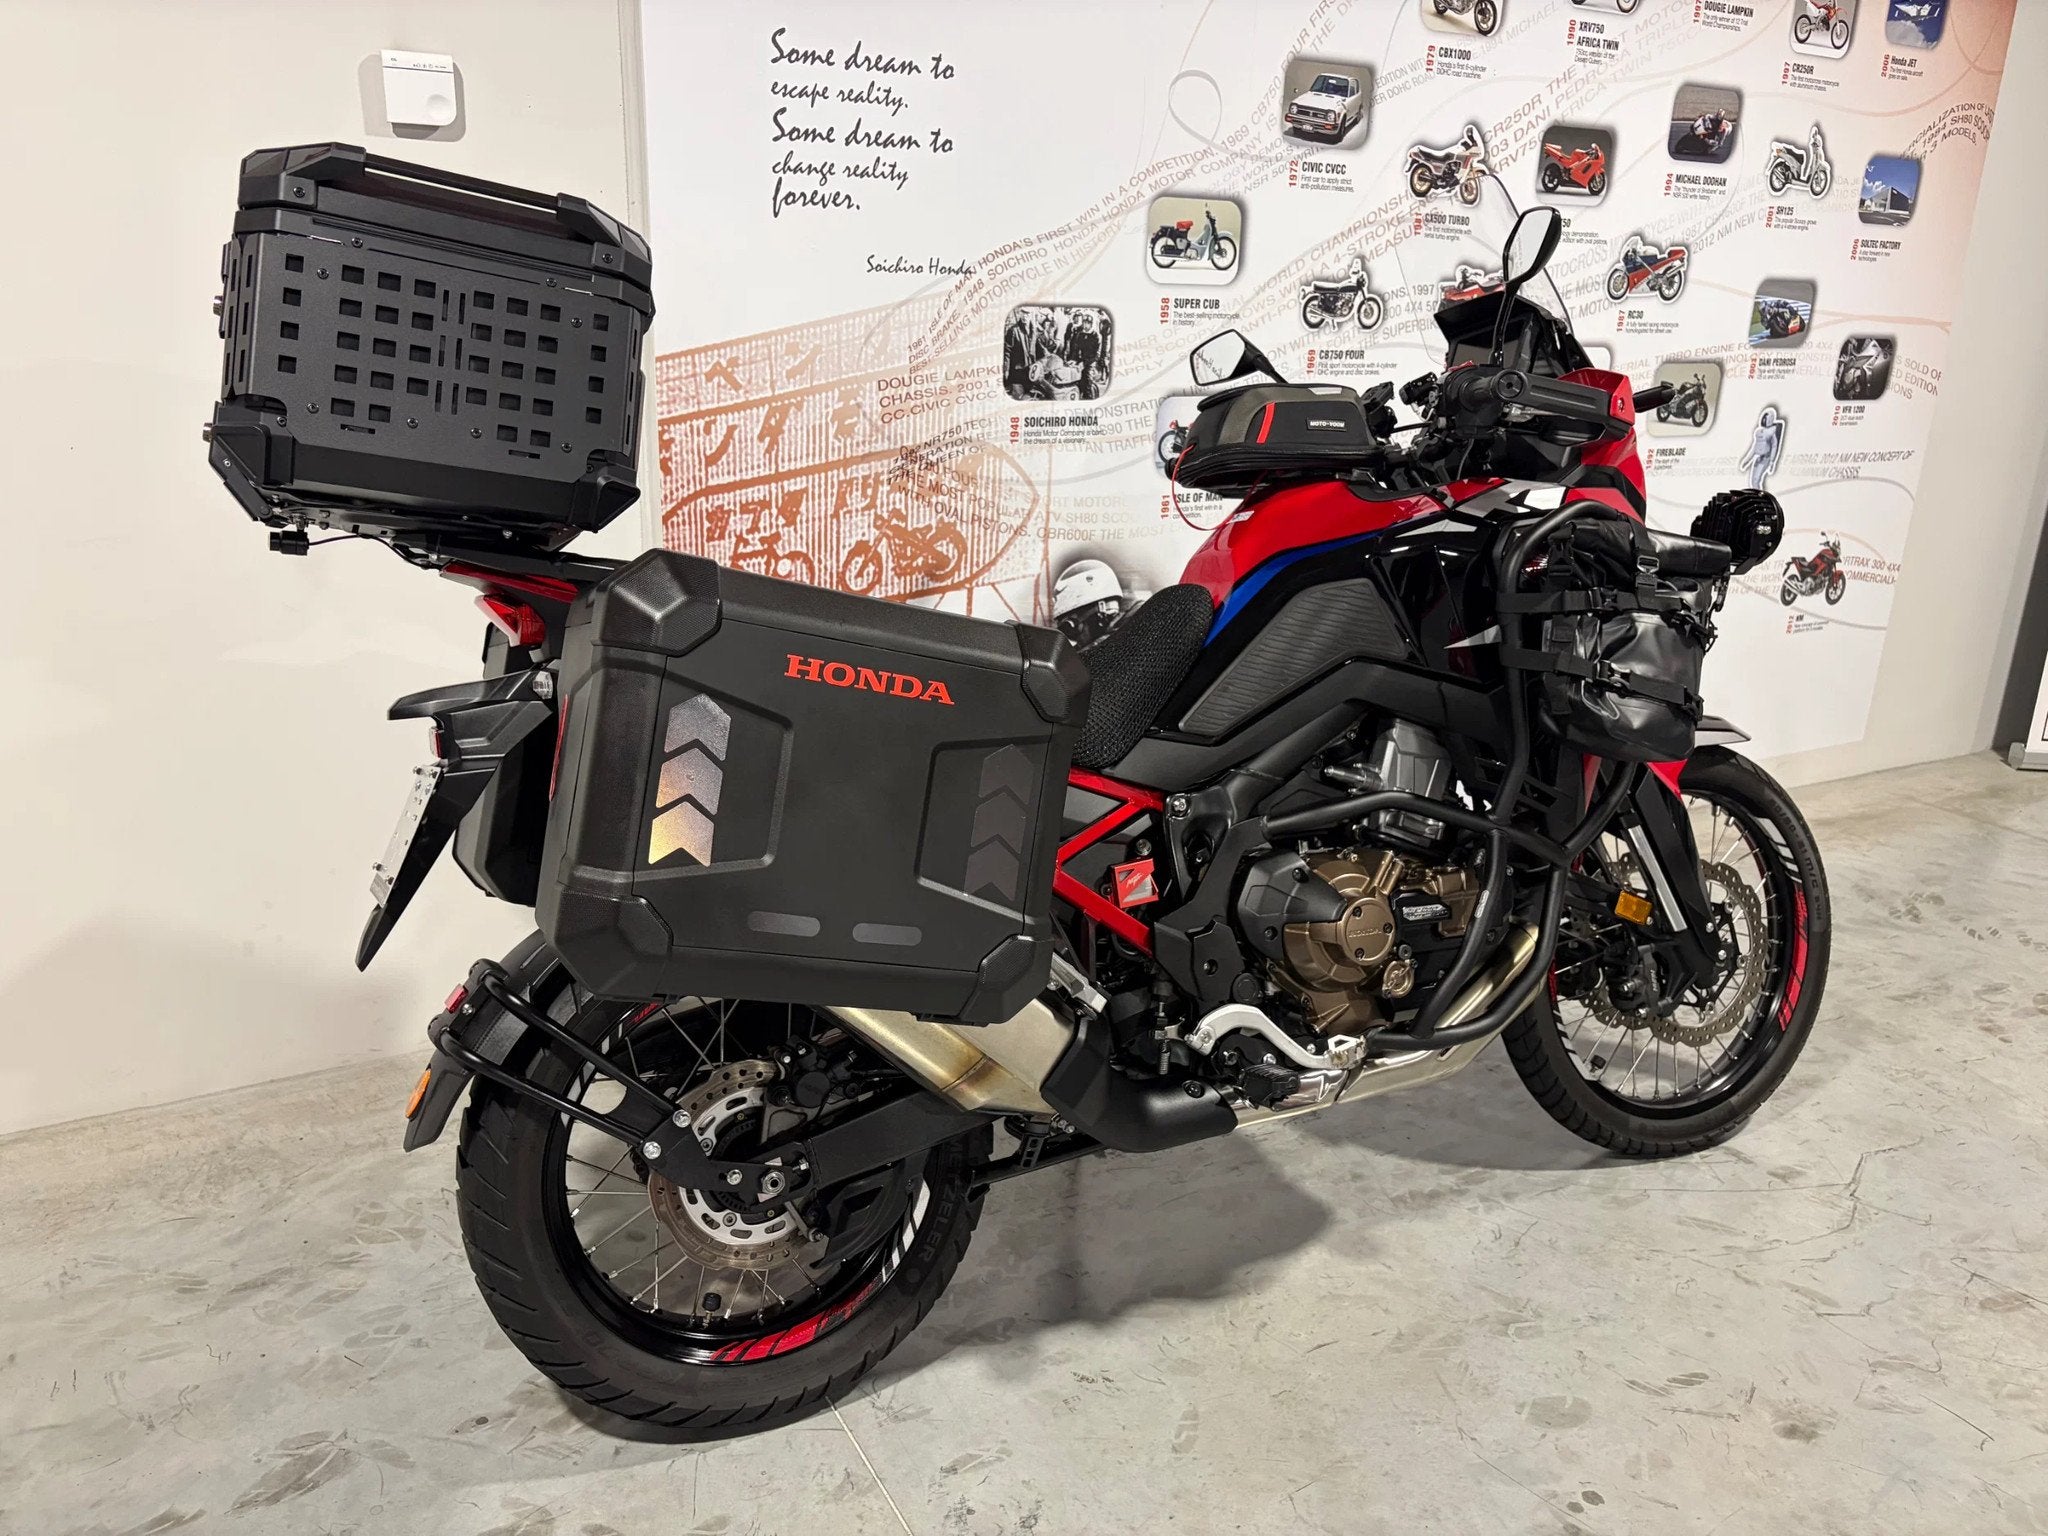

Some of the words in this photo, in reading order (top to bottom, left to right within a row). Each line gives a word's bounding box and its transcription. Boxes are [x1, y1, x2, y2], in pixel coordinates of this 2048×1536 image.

[1704, 1, 1727, 14] DOUGIE
[1727, 3, 1754, 18] LAMPKIN
[1710, 13, 1718, 21] only
[1567, 19, 1577, 46] 1990
[1579, 21, 1605, 34] XRV750
[1702, 20, 1712, 28] World
[770, 27, 836, 66] Some
[844, 40, 922, 76] dream
[930, 53, 955, 80] to
[1438, 46, 1472, 61] CBX1000
[1577, 36, 1601, 48] AFRICA
[1602, 39, 1619, 51] TWIN
[1426, 45, 1436, 72] 1979
[1881, 54, 1890, 77] 2006
[1891, 55, 1907, 67] Honda
[1907, 58, 1917, 68] JET
[1375, 66, 1407, 89] EDITION
[1782, 62, 1790, 85] 1997
[1792, 63, 1814, 75] CR250R
[1546, 66, 1578, 95] THE
[770, 80, 830, 108] escape
[836, 80, 909, 117] reality.
[771, 106, 836, 143] Some
[844, 117, 921, 150] dream
[929, 128, 954, 154] to
[1941, 127, 1977, 146] MODELS.
[771, 150, 836, 187] change
[843, 156, 909, 191] reality
[1289, 160, 1299, 187] 1972
[1301, 161, 1324, 173] CIVIC
[1325, 163, 1347, 175] CVCC
[1301, 174, 1312, 183] First
[1327, 177, 1339, 186] apply
[1340, 177, 1352, 185] strict
[1664, 173, 1674, 196] 1994
[1675, 174, 1701, 185] MICHAEL
[1702, 176, 1727, 187] DOOHAN
[772, 176, 861, 219] forever.
[908, 344, 930, 364] DISC
[963, 279, 985, 304] 1948
[988, 247, 1048, 281] SOICHIRO
[1053, 222, 1098, 251] HONDA
[1102, 190, 1147, 222] HONDA
[1148, 168, 1197, 193] MOTOR
[1200, 135, 1263, 174] COMPANY
[1309, 17, 1336, 53] THE
[907, 335, 928, 352] 1961
[928, 310, 945, 333] ISLE
[954, 266, 977, 293] MAN
[977, 237, 1034, 269] HONDA'S
[1036, 223, 1074, 244] FIRST
[1076, 204, 1100, 224] WIN
[1102, 192, 1116, 206] IN
[1118, 185, 1128, 196] A
[1129, 146, 1218, 187] COMPETITION.
[1221, 125, 1250, 150] 1969
[1251, 75, 1283, 125] CB750
[1448, 214, 1470, 226] TURBO
[1766, 206, 1774, 228] 2001
[1776, 206, 1794, 215] SH125
[1692, 234, 1716, 254] 2012
[1717, 224, 1733, 242] NM
[1734, 212, 1756, 231] NEW
[1879, 240, 1902, 249] FACTORY
[866, 254, 924, 275] Soichiro
[928, 257, 974, 277] Honda
[971, 260, 1054, 315] MOTORCYCLE
[1054, 253, 1069, 269] IN
[1071, 221, 1123, 260] HISTORY
[1253, 259, 1306, 296] WORLD
[1412, 284, 1435, 296] 1997
[1160, 297, 1170, 324] 1958
[1173, 298, 1201, 309] SUPER
[1202, 299, 1220, 310] CUB
[1405, 301, 1423, 313] 4X4
[1627, 310, 1643, 319] RC30
[1307, 349, 1316, 375] 1969
[1318, 350, 1342, 360] CB750
[1344, 350, 1365, 360] FOUR
[1655, 350, 1692, 364] TURBO
[1695, 342, 1734, 357] ENGINE
[1772, 358, 1796, 366] PEDROSA
[1904, 358, 1929, 375] SOLD
[877, 372, 939, 392] DOUGIE
[1905, 372, 1939, 396] EDITION
[879, 384, 953, 408] CHASSIS.
[957, 380, 991, 393] 2001
[955, 390, 998, 405] CVCC
[1832, 406, 1840, 426] 2010
[1842, 405, 1852, 413] VFR
[1010, 416, 1020, 444] 1948
[1023, 416, 1067, 428] SOICHIRO
[1069, 415, 1099, 427] HONDA
[1125, 418, 1152, 430] THE
[924, 425, 962, 449] NR750
[1023, 429, 1041, 437] Honda
[1042, 429, 1059, 437] Motor
[1059, 429, 1085, 438] Company
[1656, 447, 1686, 456] FIREBLADE
[929, 478, 965, 501] MOST
[1066, 512, 1099, 524] SH80
[1161, 495, 1170, 519] 1961
[1193, 492, 1203, 503] OF
[898, 485, 931, 508] WITH
[934, 502, 966, 523] OVAL
[1036, 526, 1096, 541] CBR600F
[1101, 527, 1125, 540] THE
[1872, 560, 1886, 571] 300
[1886, 562, 1902, 573] 4X4
[784, 653, 955, 706] HONDA
